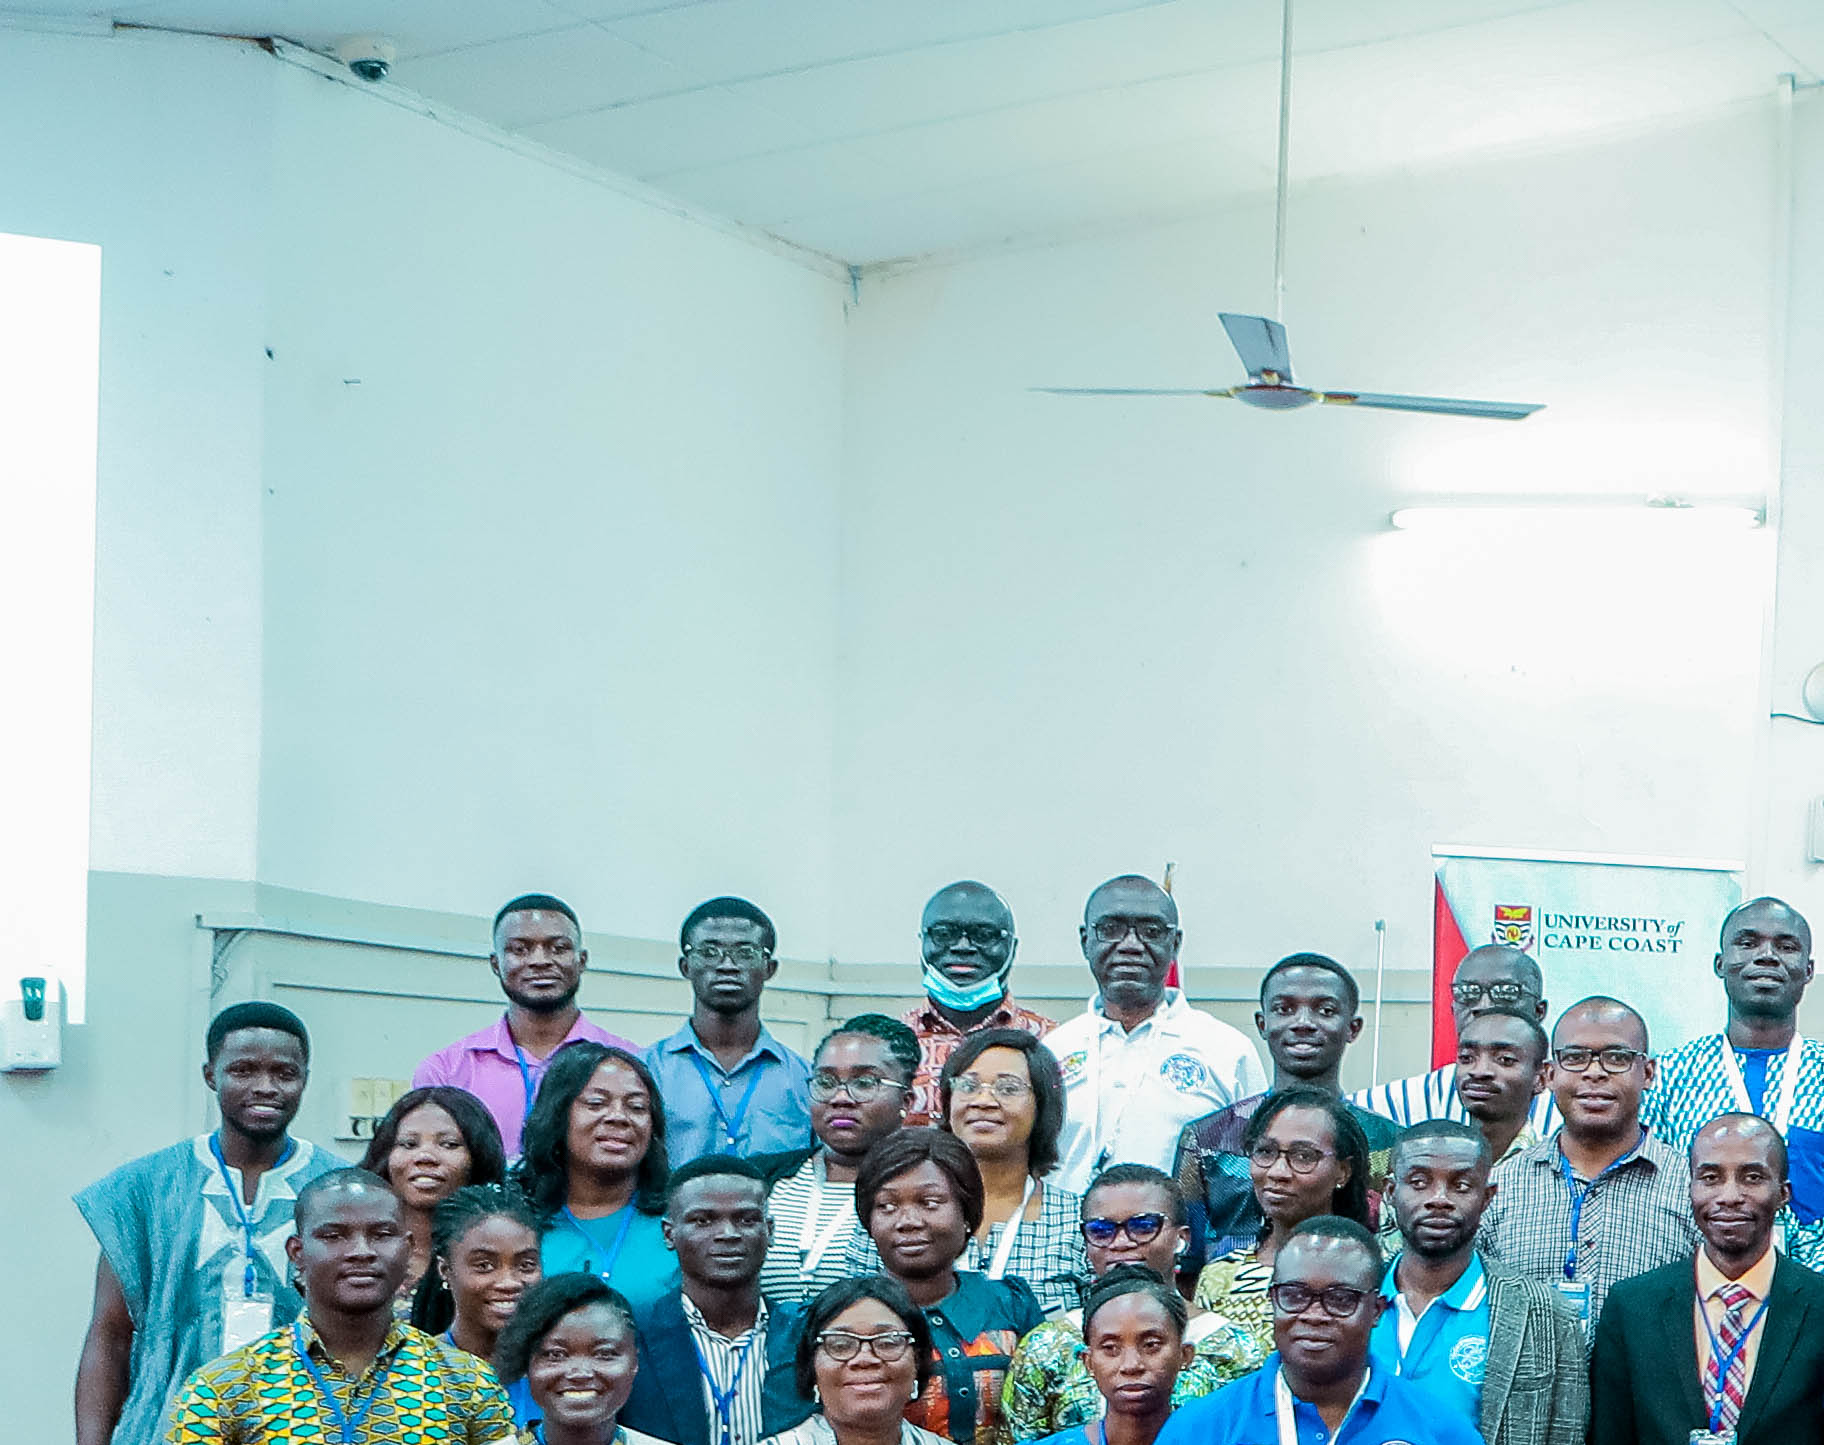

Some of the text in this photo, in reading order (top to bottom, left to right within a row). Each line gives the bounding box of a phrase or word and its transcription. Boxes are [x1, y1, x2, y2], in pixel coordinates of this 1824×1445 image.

[1544, 913, 1685, 936] UNIVERSITY of
[1544, 933, 1683, 954] CAPE COAST
